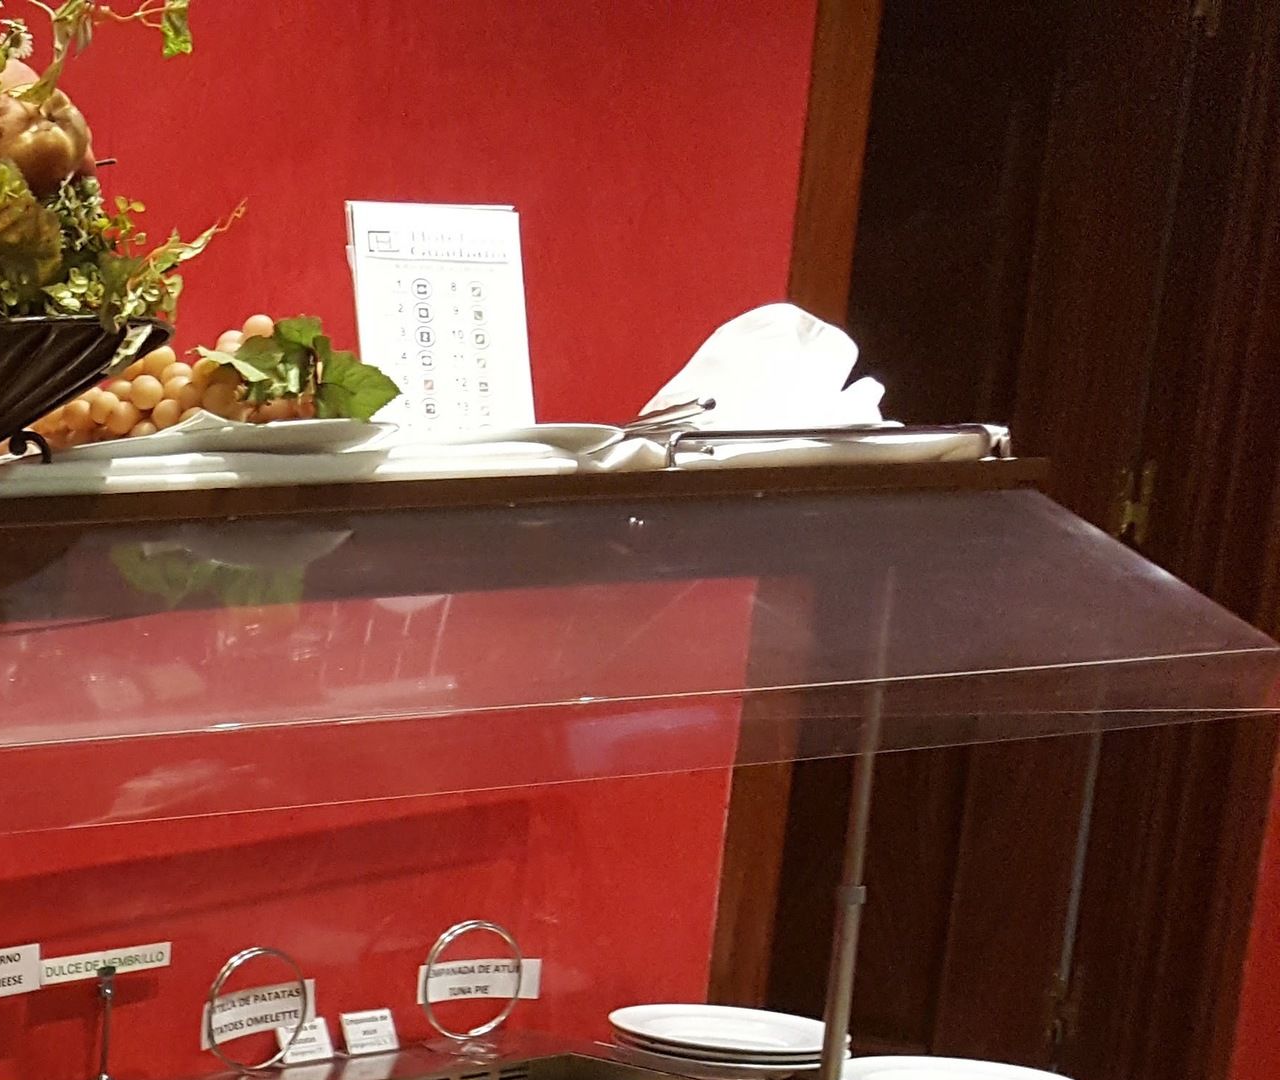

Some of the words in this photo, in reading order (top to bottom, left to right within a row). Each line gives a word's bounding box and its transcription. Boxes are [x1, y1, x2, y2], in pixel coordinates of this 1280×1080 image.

[45, 961, 82, 978] DULCE
[85, 959, 100, 972] DE
[478, 964, 490, 974] DE
[253, 988, 300, 1004] PATATAS
[475, 984, 489, 995] PIE
[246, 1009, 299, 1027] OMELETTE
